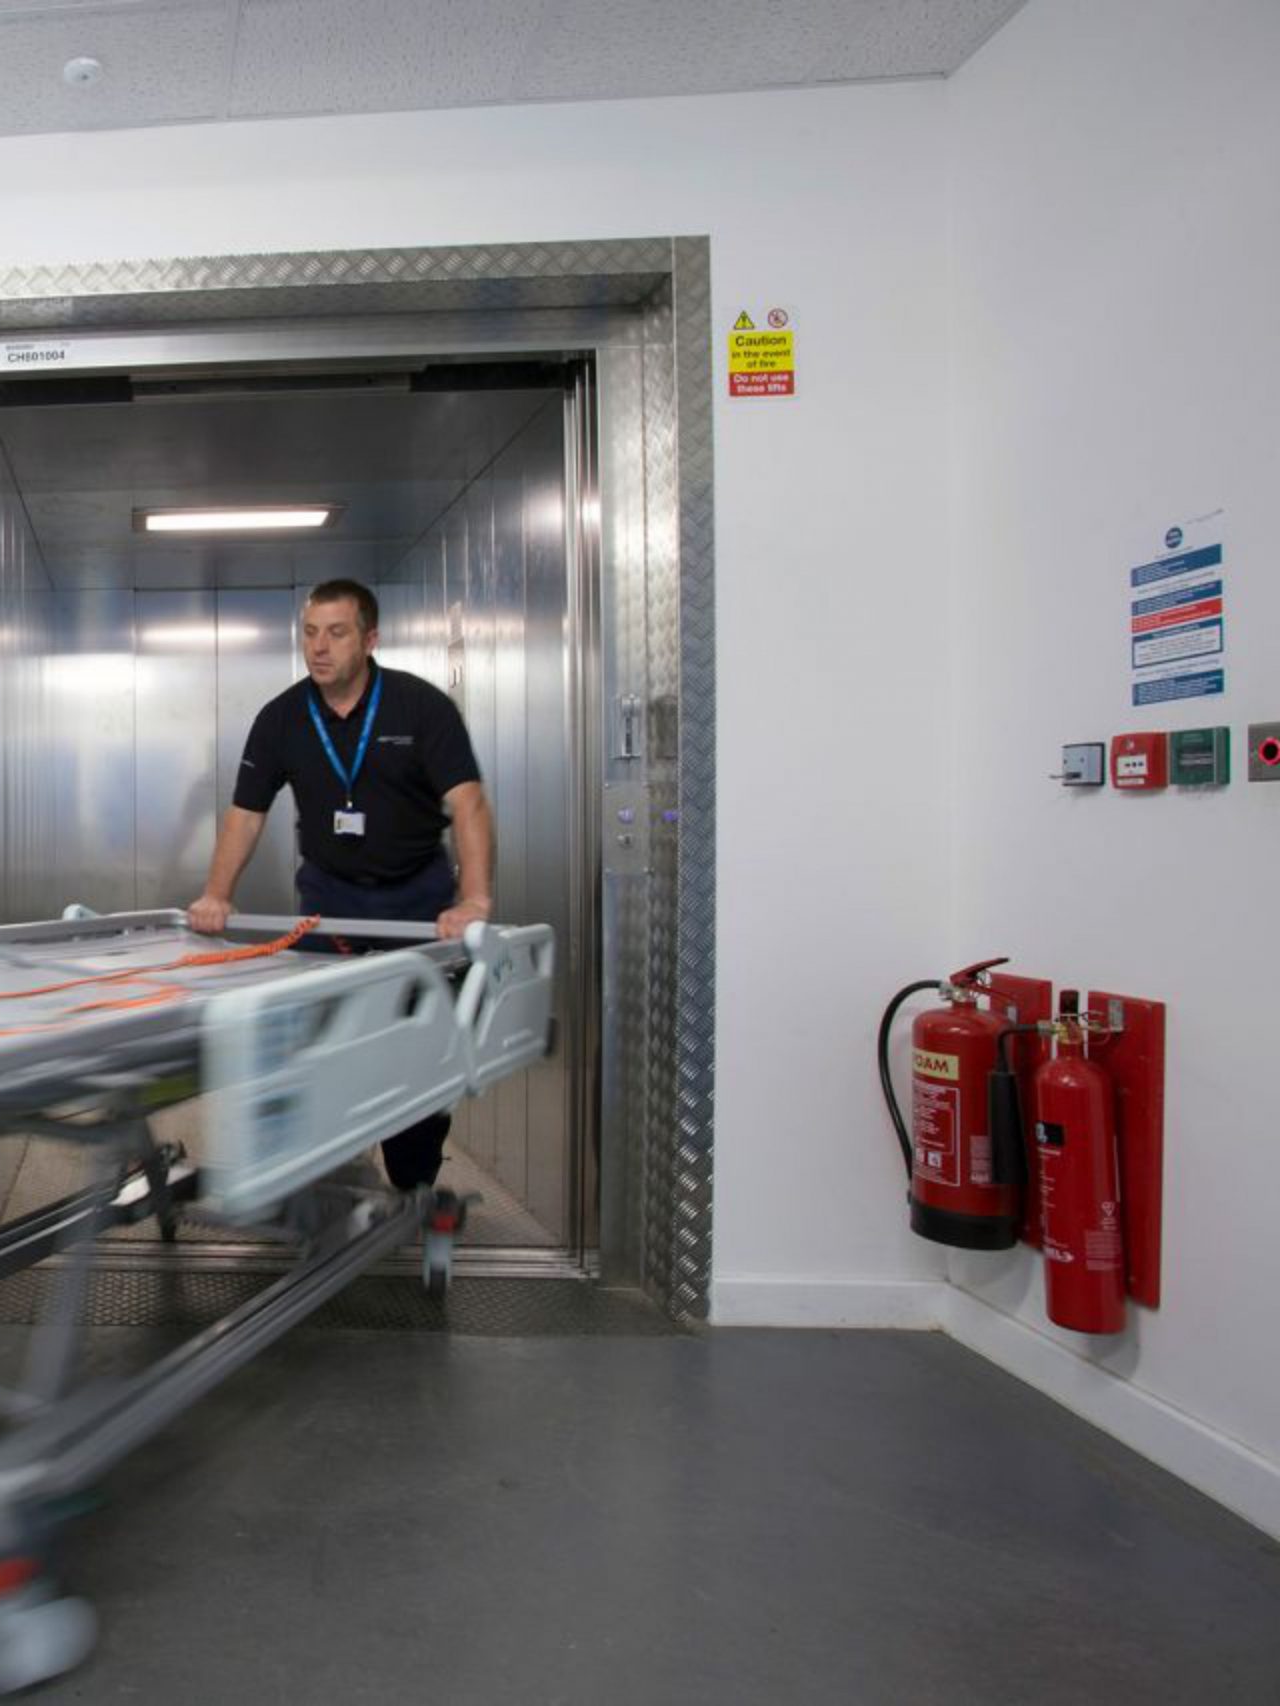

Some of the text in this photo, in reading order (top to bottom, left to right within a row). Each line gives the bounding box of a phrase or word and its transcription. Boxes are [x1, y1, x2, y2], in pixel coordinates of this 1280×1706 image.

[735, 336, 787, 347] Caution
[731, 349, 791, 359] in the event
[746, 359, 776, 369] of fire
[733, 373, 789, 383] Do not use
